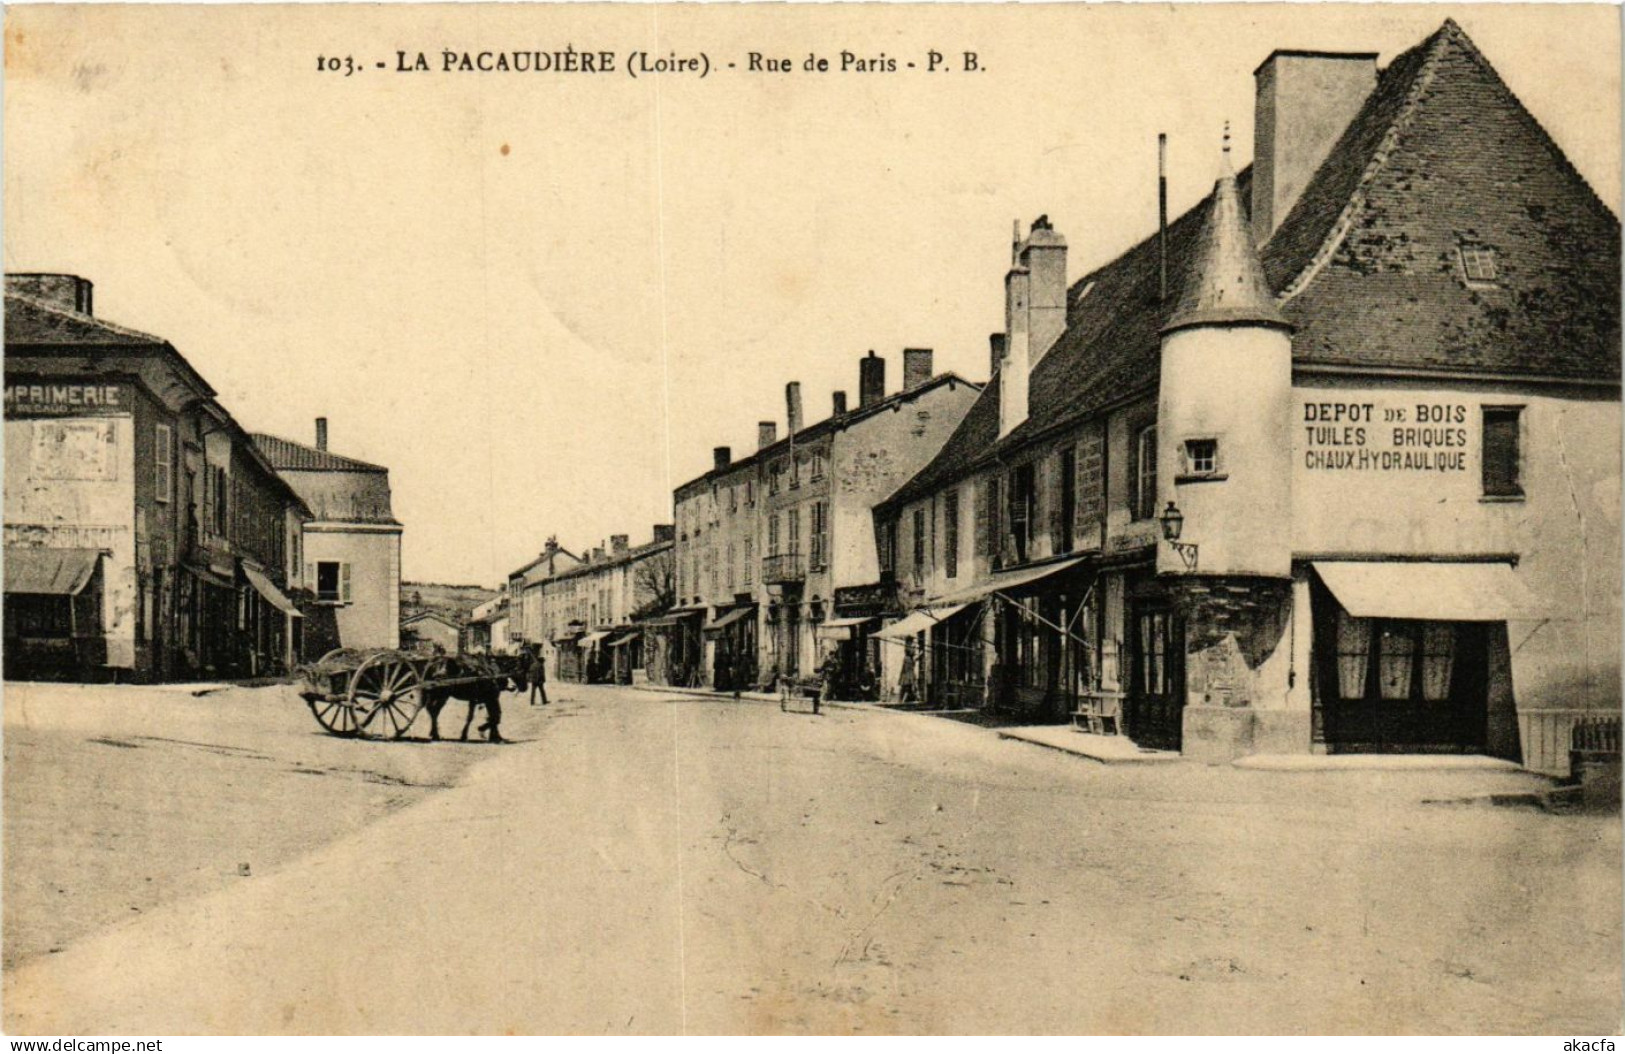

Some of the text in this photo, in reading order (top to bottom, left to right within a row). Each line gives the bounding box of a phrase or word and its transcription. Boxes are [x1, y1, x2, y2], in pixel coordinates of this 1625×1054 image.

[1304, 403, 1467, 423] DEPOT DE BOIS
[1305, 426, 1467, 448] TUILES BRIQUES
